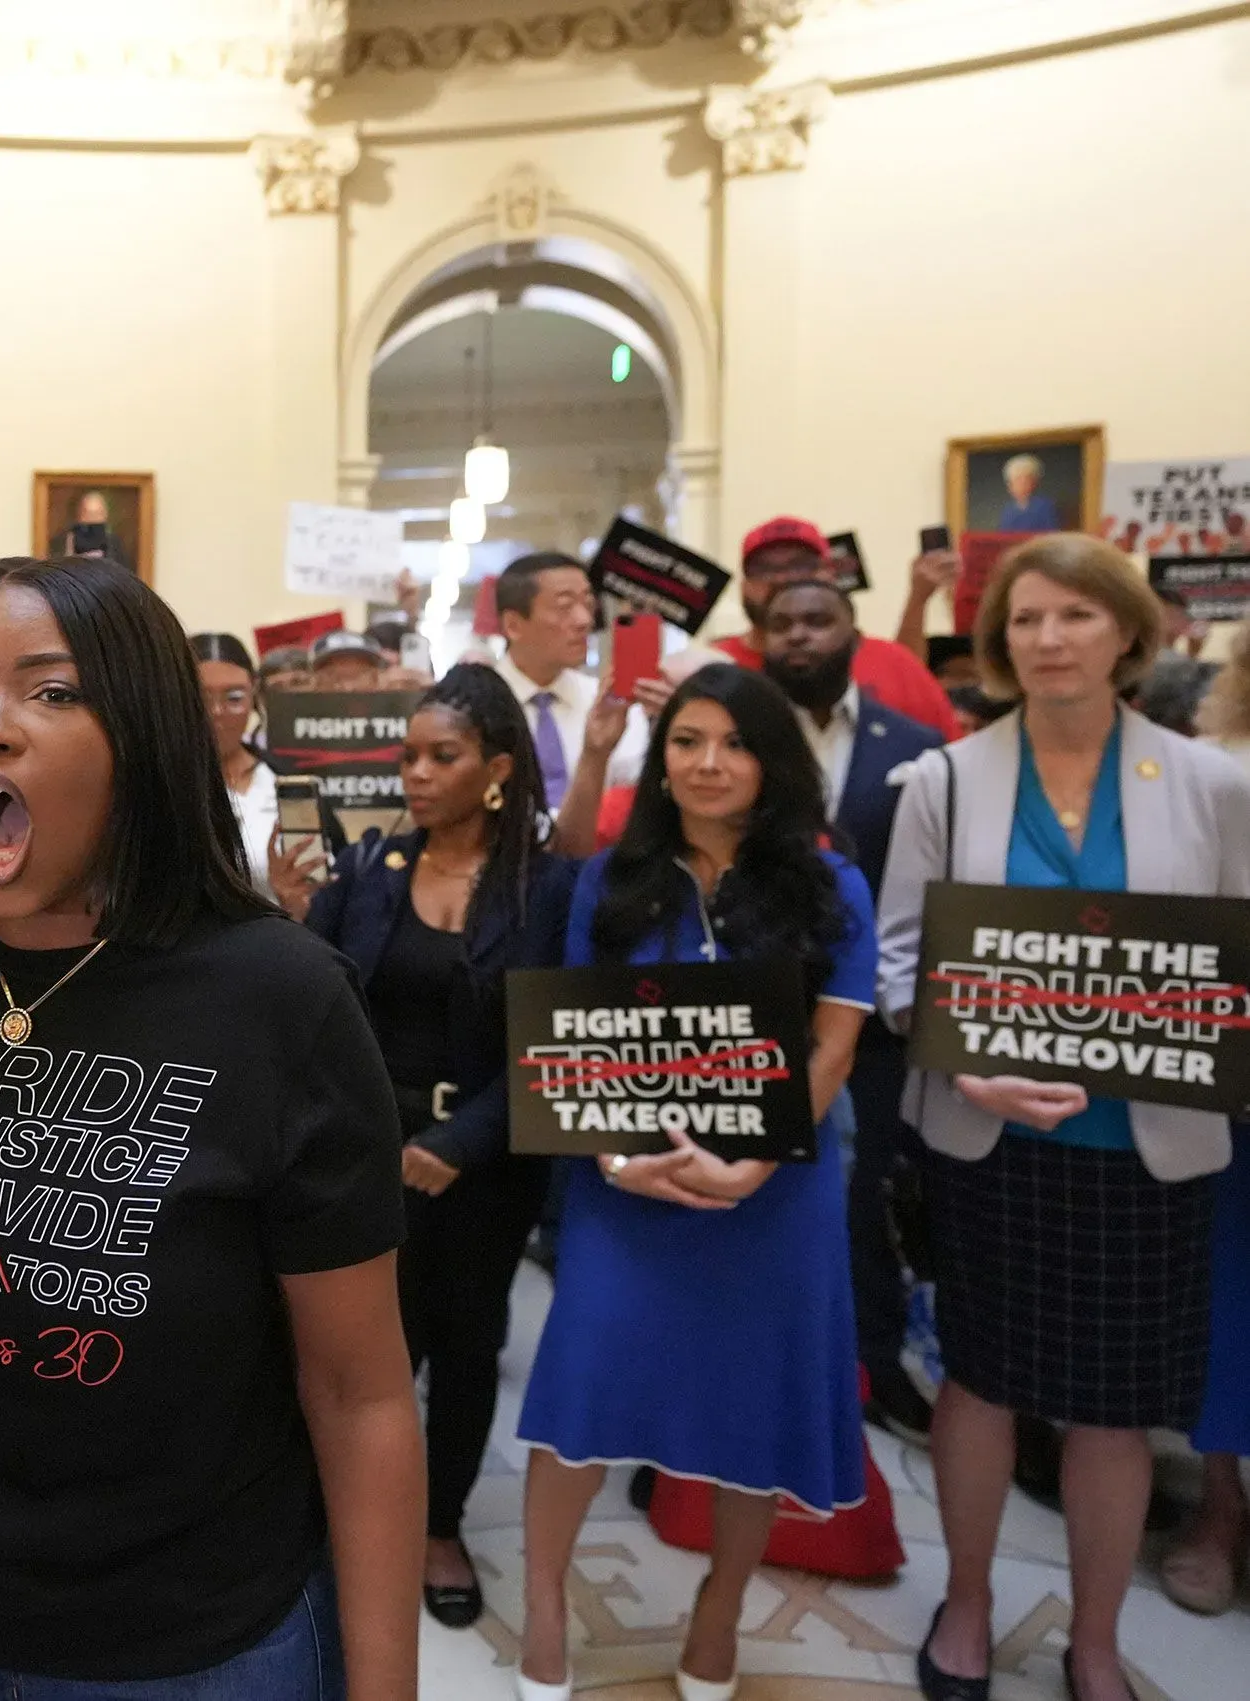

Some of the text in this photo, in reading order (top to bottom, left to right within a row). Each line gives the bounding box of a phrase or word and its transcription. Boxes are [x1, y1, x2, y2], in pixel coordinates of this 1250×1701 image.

[293, 715, 408, 740] FIGHT TH
[971, 925, 1221, 980] FIGHT THE
[551, 1004, 755, 1039] FIGHT THE
[936, 960, 1250, 1045] TRUMP
[526, 1037, 786, 1100] TRUMP
[958, 1021, 1216, 1087] TAKEOVER
[551, 1100, 766, 1136] TAKEOVER
[33, 1325, 124, 1387] 30
